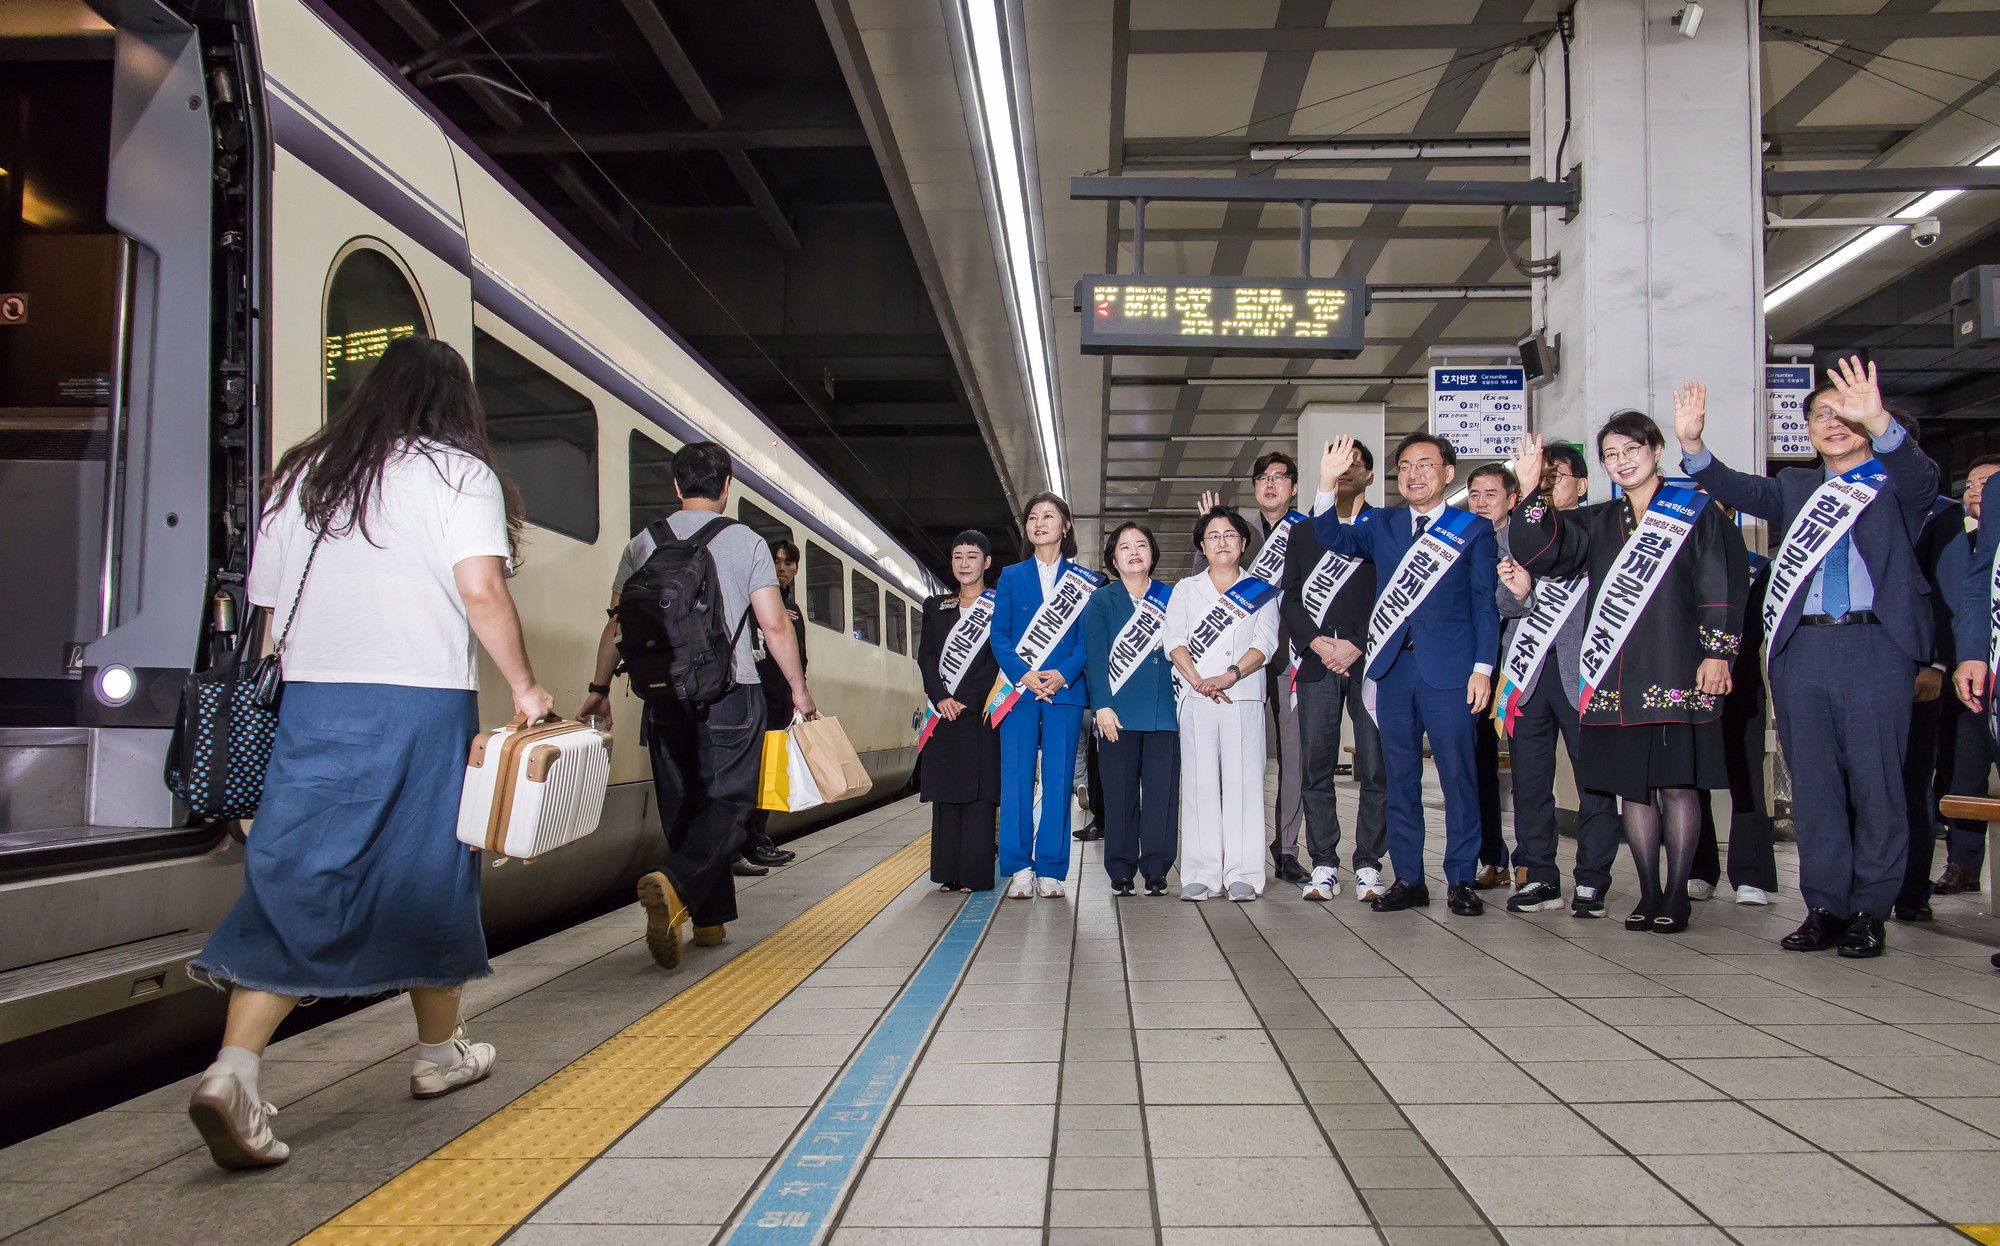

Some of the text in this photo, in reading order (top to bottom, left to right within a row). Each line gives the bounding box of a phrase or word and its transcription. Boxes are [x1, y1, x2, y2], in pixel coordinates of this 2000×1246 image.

[1441, 374, 1478, 385] 호차번호
[1850, 489, 1871, 504] 권리
[1657, 500, 1695, 516] 조국혁신당
[1434, 526, 1465, 545] 조국혁신당
[1644, 516, 1687, 536] 행복할 권리
[1510, 632, 1540, 683] 추석
[1582, 624, 1615, 679] 추석
